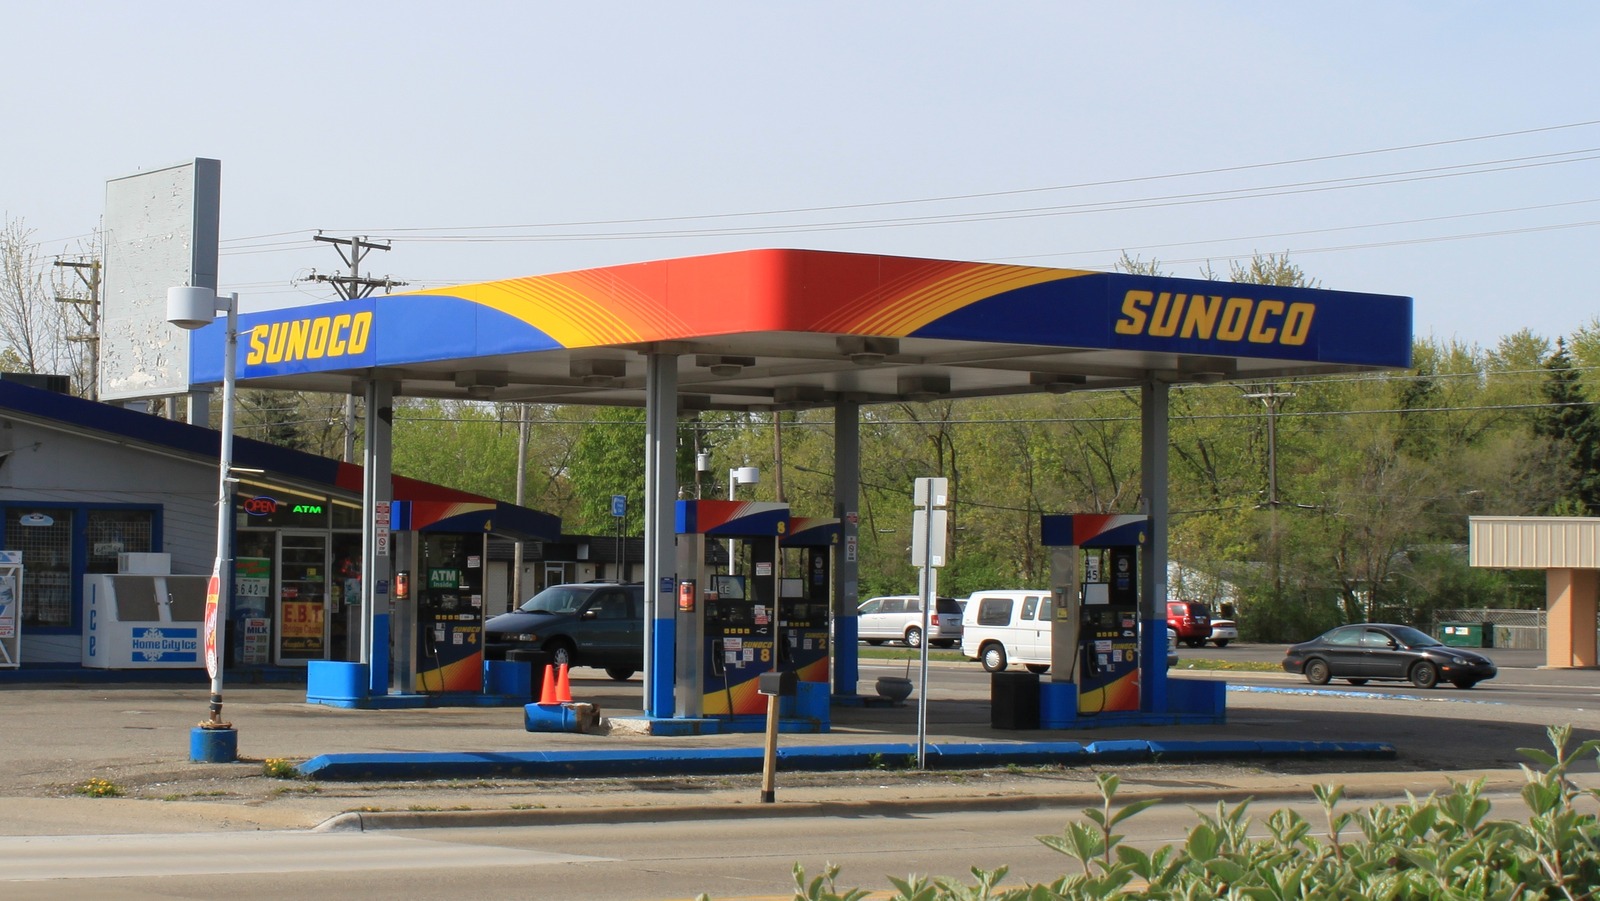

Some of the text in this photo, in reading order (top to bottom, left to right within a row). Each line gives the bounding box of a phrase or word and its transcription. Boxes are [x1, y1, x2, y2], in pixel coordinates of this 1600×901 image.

[1115, 289, 1316, 346] SUNOCO
[246, 310, 373, 365] SUNOCO
[244, 499, 277, 513] OPEN
[293, 505, 322, 514] ATM
[483, 519, 492, 531] 4
[777, 521, 786, 534] 8
[831, 533, 839, 544] 2
[1138, 531, 1146, 544] 6
[431, 570, 456, 581] ATM
[1087, 570, 1097, 580] 45
[247, 626, 268, 634] MILK
[467, 633, 477, 644] 4
[818, 638, 827, 649] 2
[132, 640, 197, 651] Home City Ice
[760, 648, 770, 662] 8
[1125, 649, 1134, 662] 6
